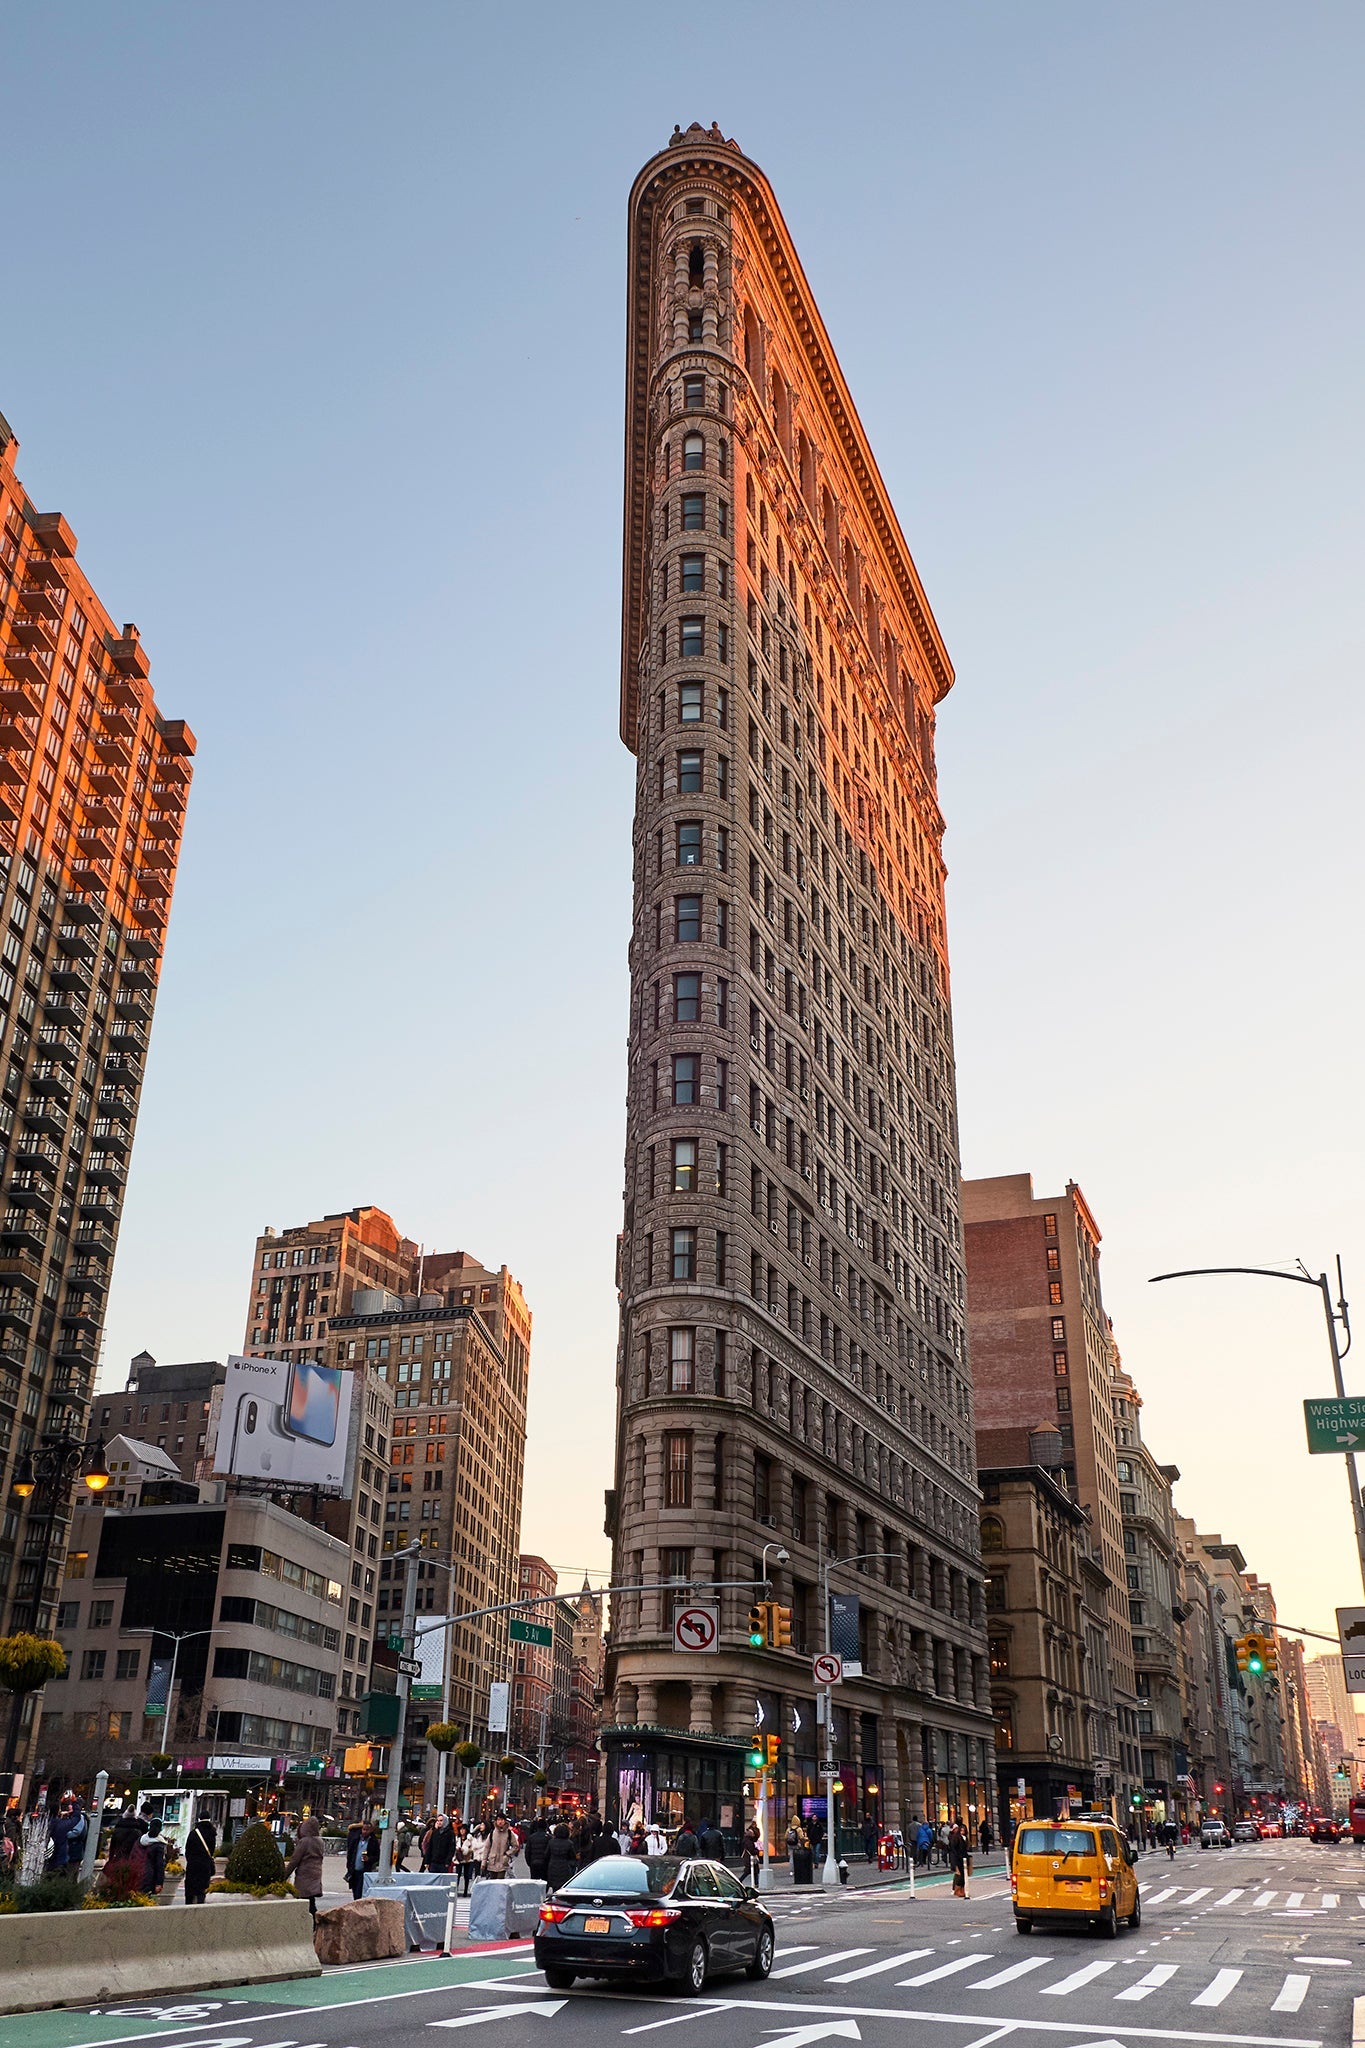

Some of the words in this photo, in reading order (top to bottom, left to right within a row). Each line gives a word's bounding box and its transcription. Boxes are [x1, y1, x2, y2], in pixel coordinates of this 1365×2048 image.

[241, 1362, 269, 1374] iPhone
[270, 1366, 277, 1375] X
[1310, 1404, 1344, 1416] West
[525, 1626, 529, 1639] 5
